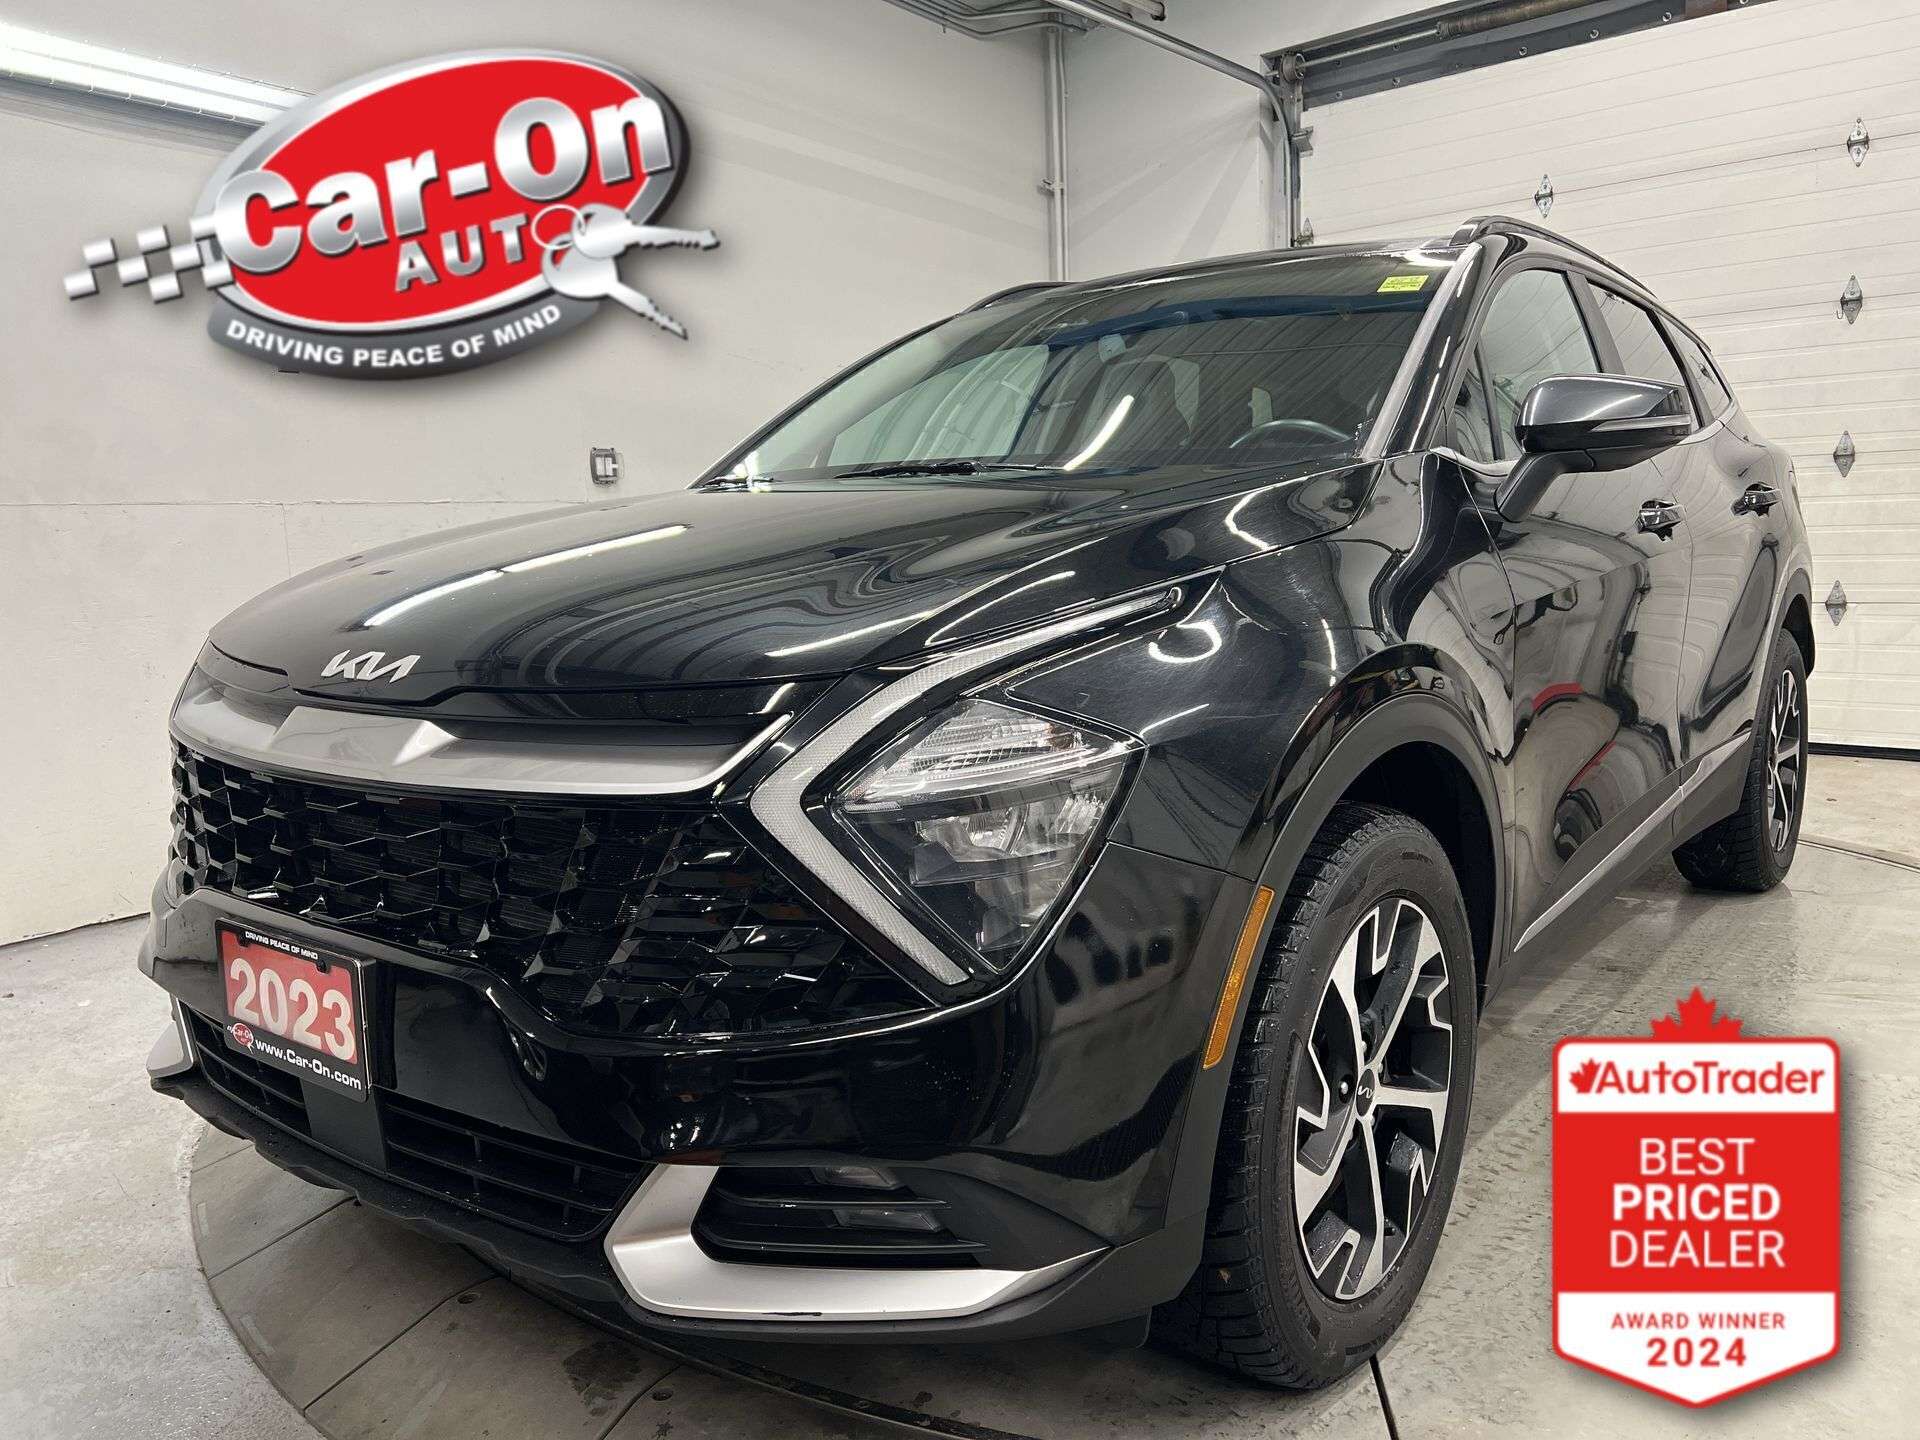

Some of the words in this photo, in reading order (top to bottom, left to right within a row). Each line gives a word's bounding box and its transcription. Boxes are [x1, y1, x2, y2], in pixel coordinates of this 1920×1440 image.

[320, 649, 421, 684] KIA
[245, 931, 269, 945] DRIVING
[269, 938, 290, 951] PEACE
[290, 945, 301, 954] OF
[300, 948, 318, 960] MIND
[230, 957, 356, 1061] 2023
[255, 1039, 362, 1090] www.Car-On.com
